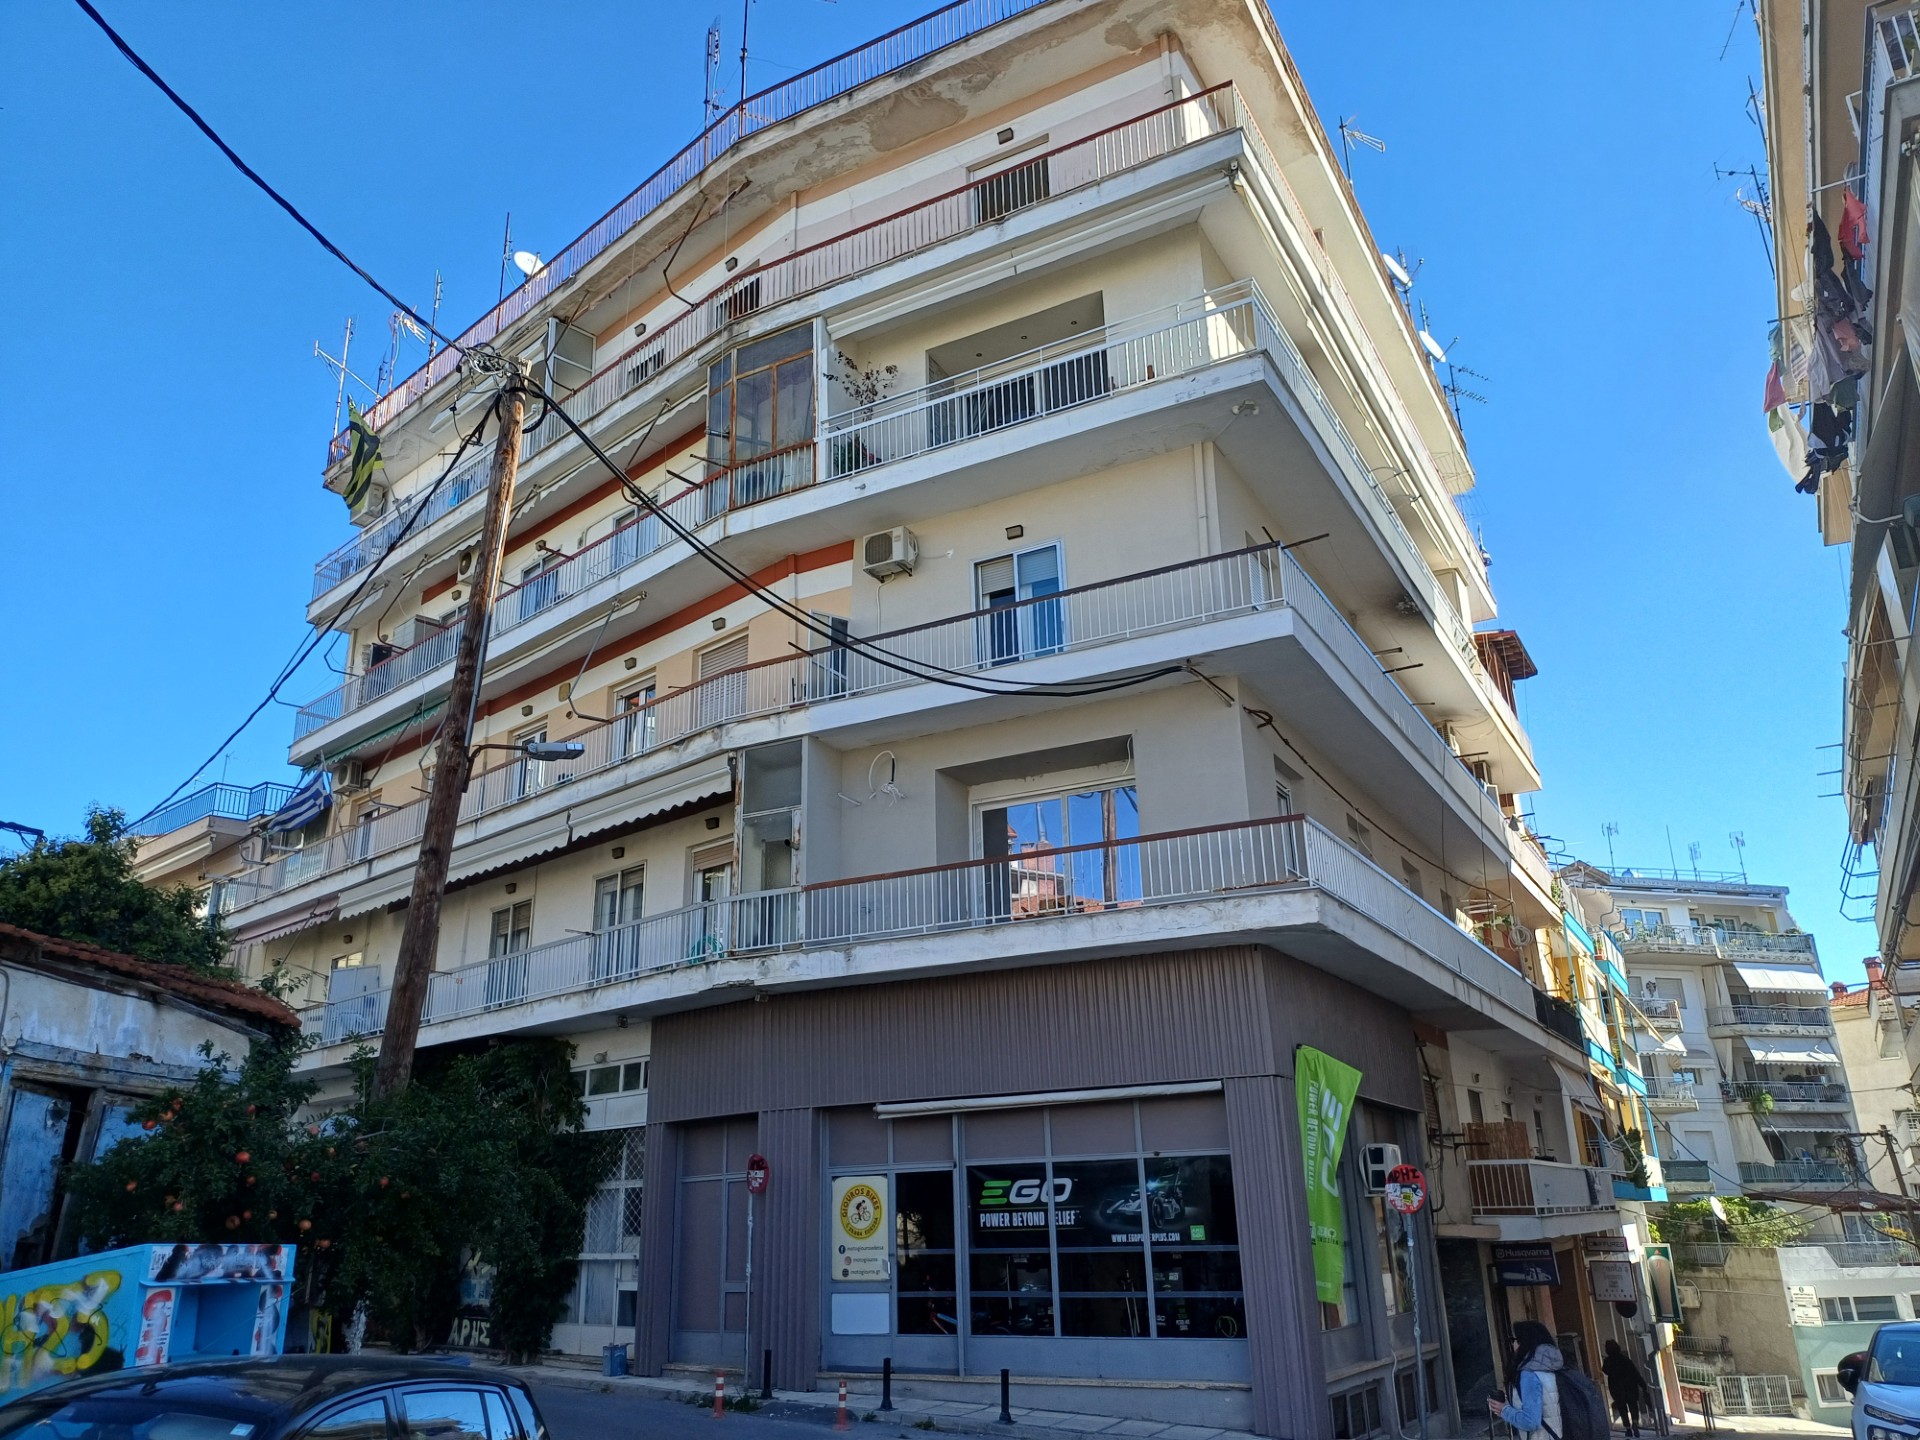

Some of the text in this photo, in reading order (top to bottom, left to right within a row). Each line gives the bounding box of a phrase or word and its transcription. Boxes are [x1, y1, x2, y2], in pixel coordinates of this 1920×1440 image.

[1308, 1079, 1319, 1115] POWER
[1307, 1117, 1319, 1156] BEYOND
[866, 1190, 879, 1210] BIKES
[979, 1177, 1073, 1205] EGO
[980, 1210, 1076, 1228] POWER BEYOND ELIEF
[1505, 1248, 1550, 1257] Husqvarna
